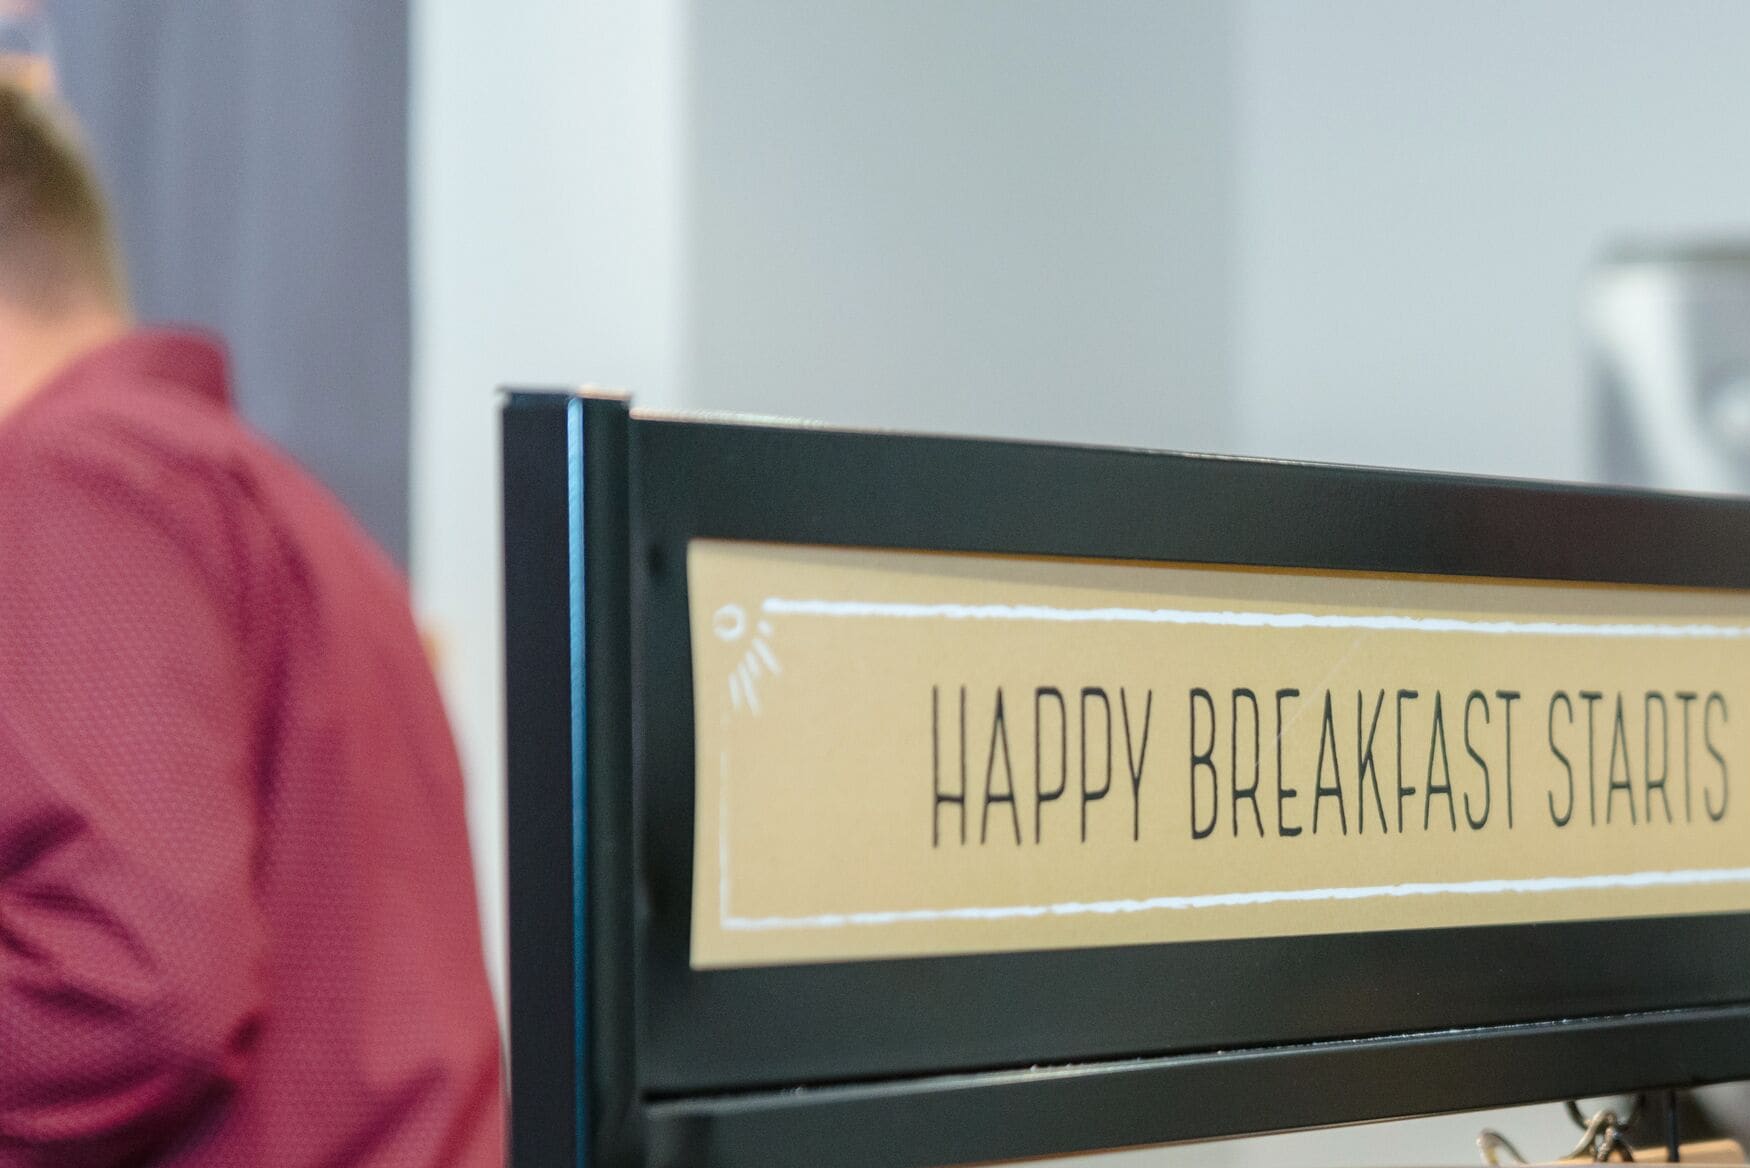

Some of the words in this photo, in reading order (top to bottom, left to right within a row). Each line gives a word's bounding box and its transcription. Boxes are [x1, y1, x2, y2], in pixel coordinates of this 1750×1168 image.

[930, 684, 1153, 849] HAPPY
[1188, 686, 1522, 841] BREAKFAST
[1547, 689, 1729, 829] STARTS
